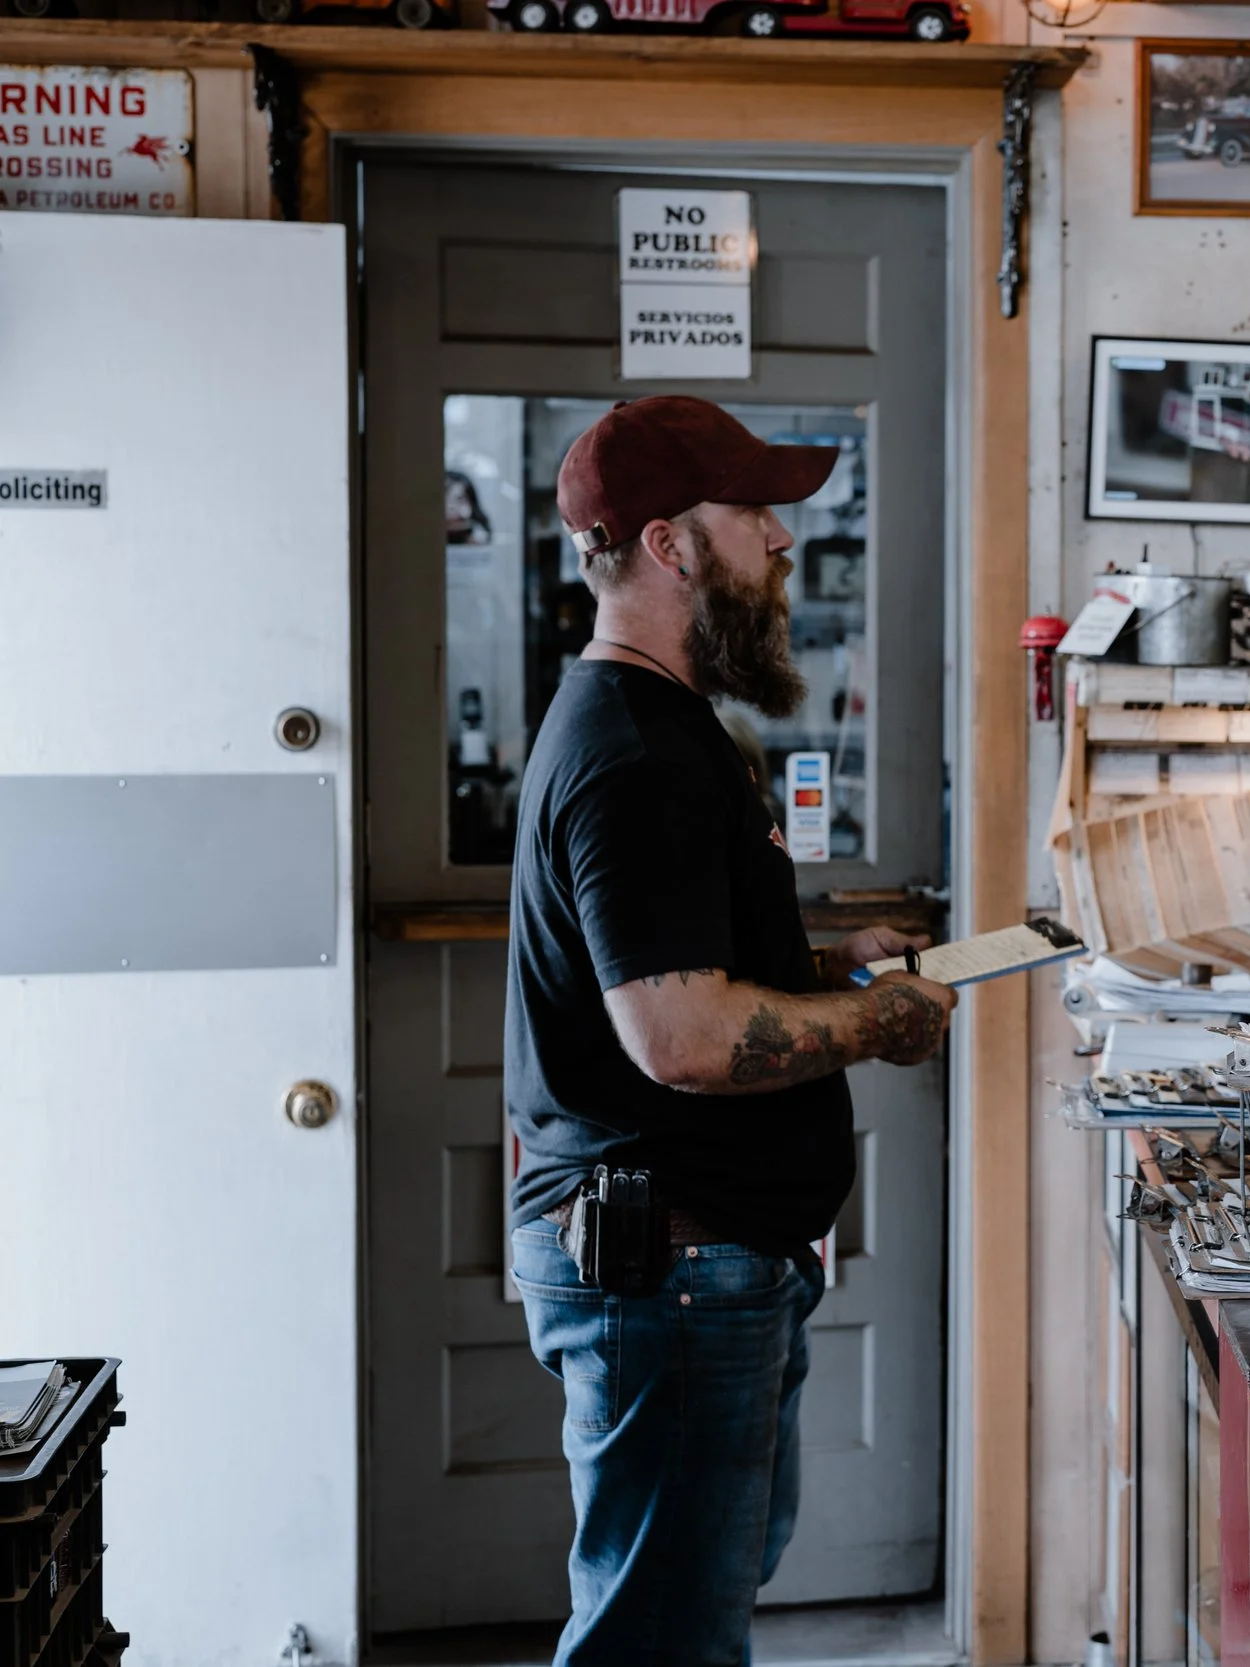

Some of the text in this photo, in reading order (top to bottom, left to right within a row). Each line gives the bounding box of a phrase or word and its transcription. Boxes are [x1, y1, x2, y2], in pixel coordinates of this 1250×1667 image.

[1, 83, 146, 116] RNING
[43, 125, 106, 147] LINE
[0, 156, 112, 179] OSSING
[16, 189, 139, 210] PETROLEUM
[663, 204, 705, 225] NO
[632, 231, 740, 254] PUBLIC
[628, 257, 742, 272] RESTROOMS
[637, 311, 735, 325] SERVICIOS
[628, 329, 744, 345] PRIVADOS
[0, 477, 102, 507] oliciting
